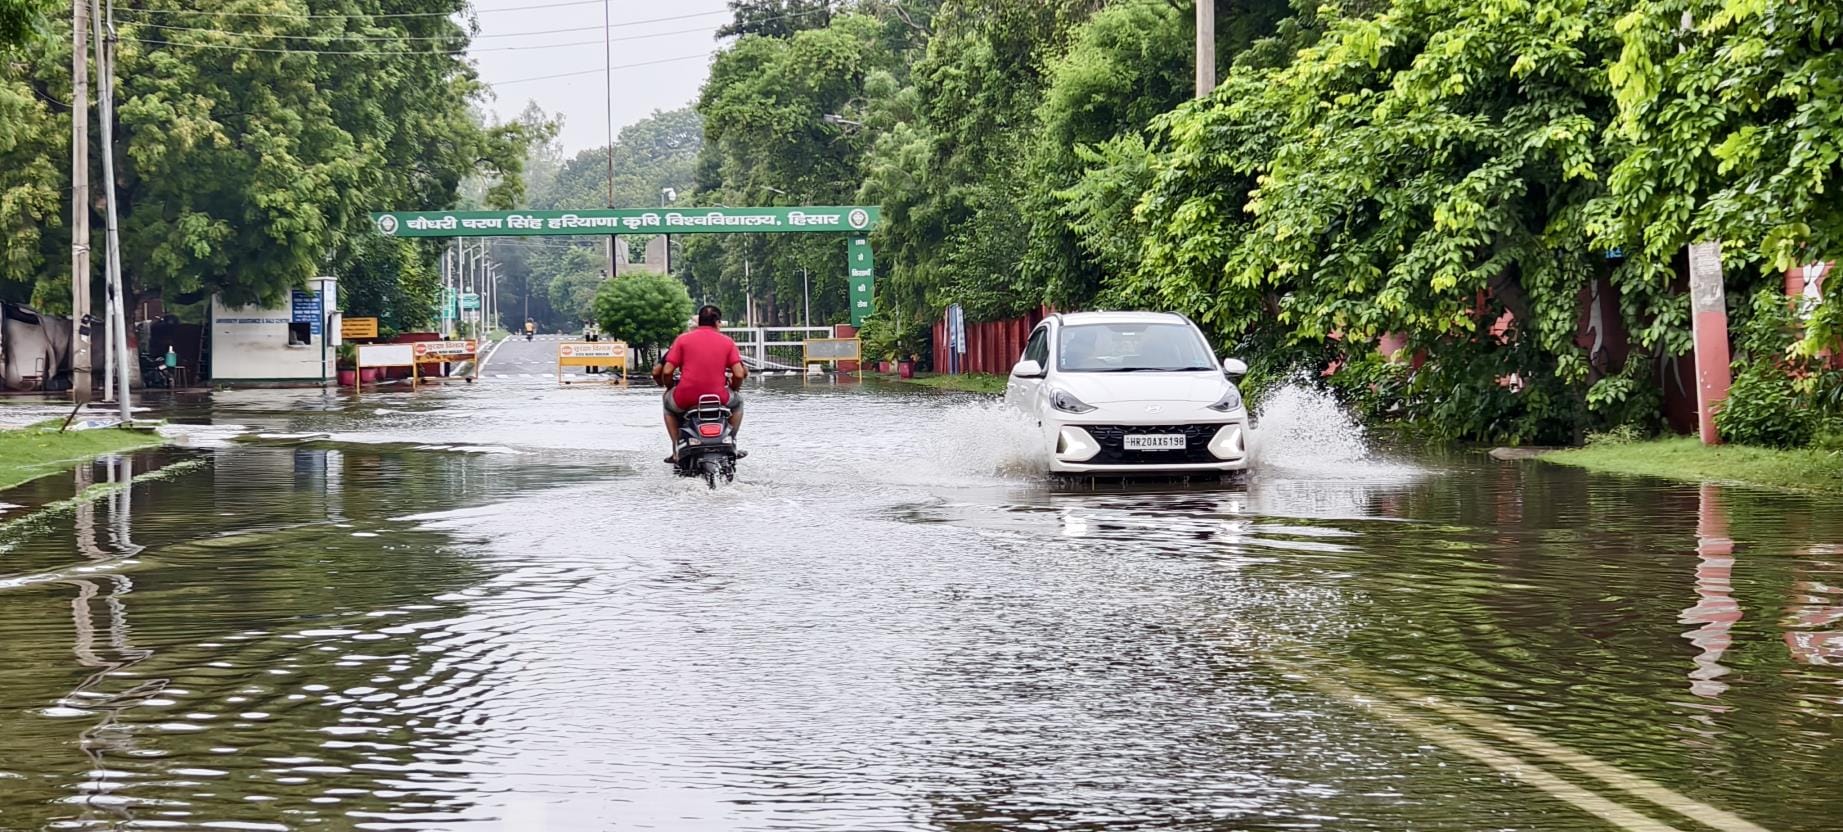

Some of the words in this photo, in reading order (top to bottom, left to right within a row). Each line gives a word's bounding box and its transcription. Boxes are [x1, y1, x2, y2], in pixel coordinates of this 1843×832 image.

[406, 215, 458, 229] चौधरी
[461, 218, 503, 229] चरण
[506, 214, 543, 229] सिंह
[547, 214, 618, 228] हरियाणा
[621, 212, 661, 229] कृषि
[787, 211, 840, 226] हिसार
